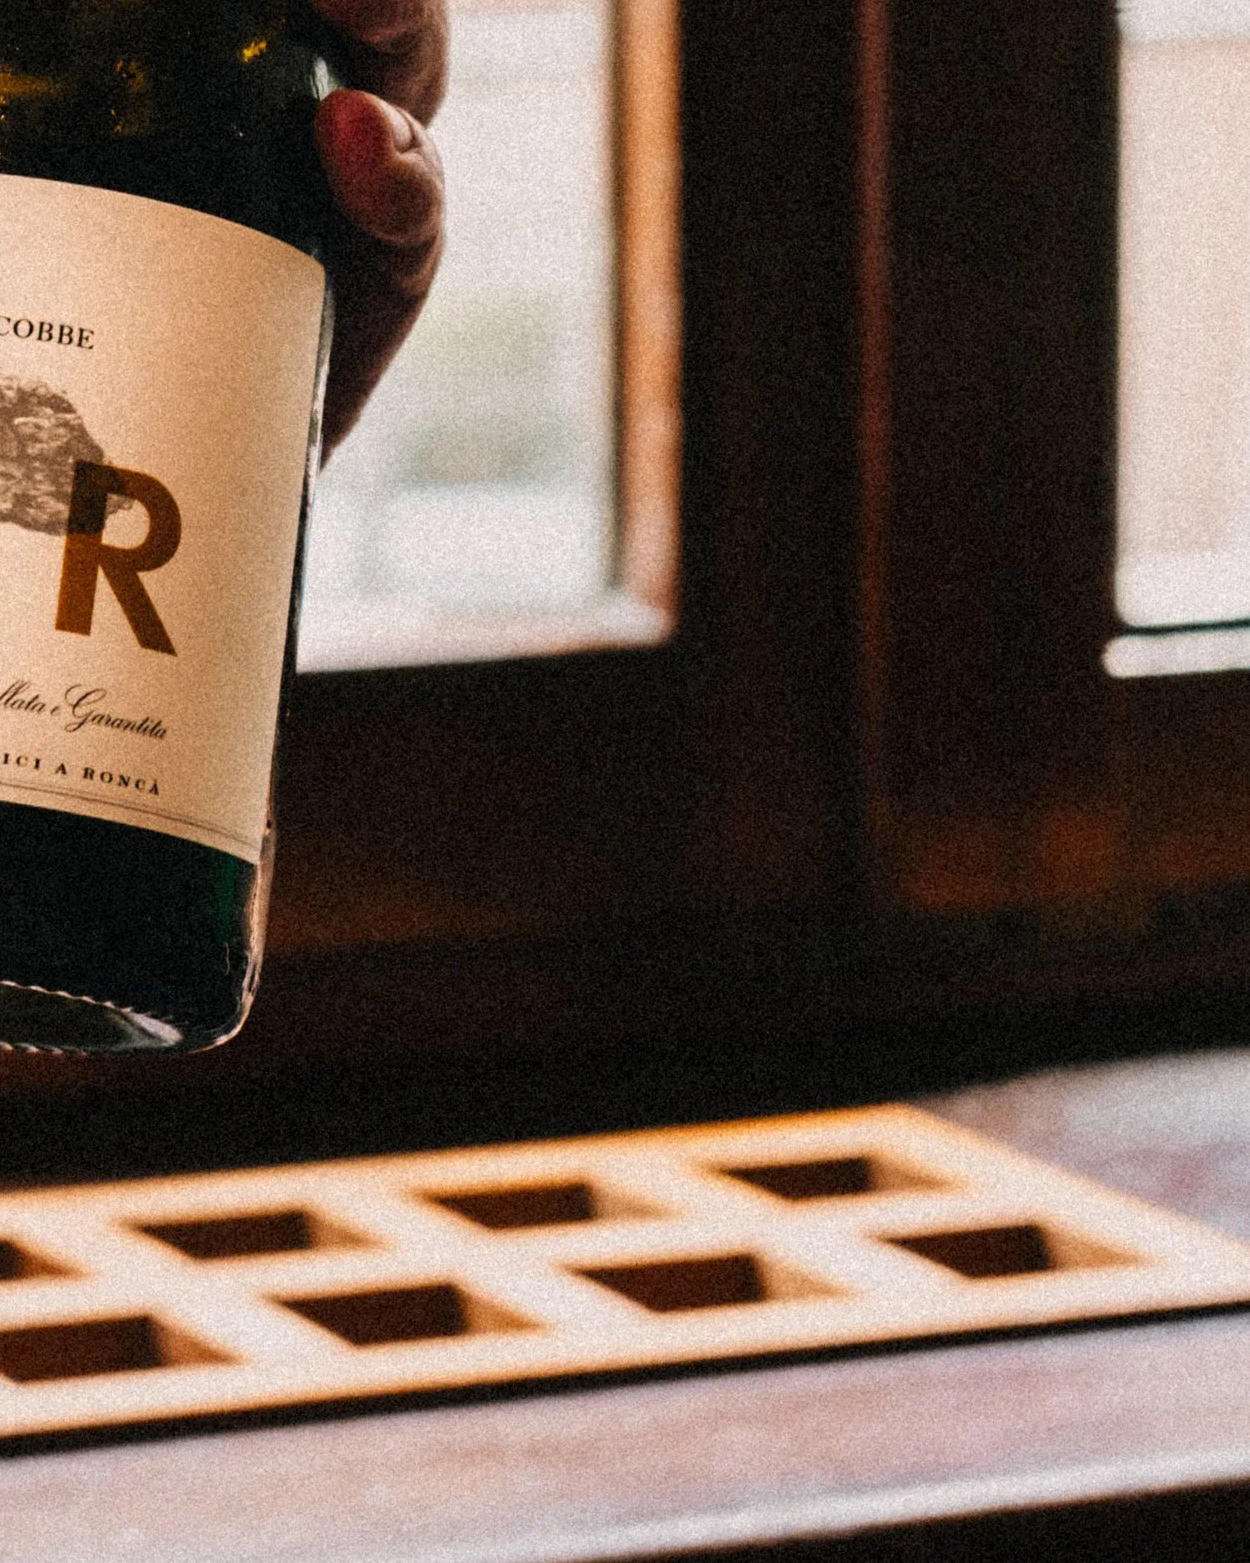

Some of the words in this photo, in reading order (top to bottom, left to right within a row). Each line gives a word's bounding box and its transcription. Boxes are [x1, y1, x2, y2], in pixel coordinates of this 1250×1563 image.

[55, 459, 182, 657] R
[50, 705, 62, 716] e
[64, 683, 168, 740] Garantita
[54, 763, 69, 776] A
[82, 766, 161, 796] RONCÀ
